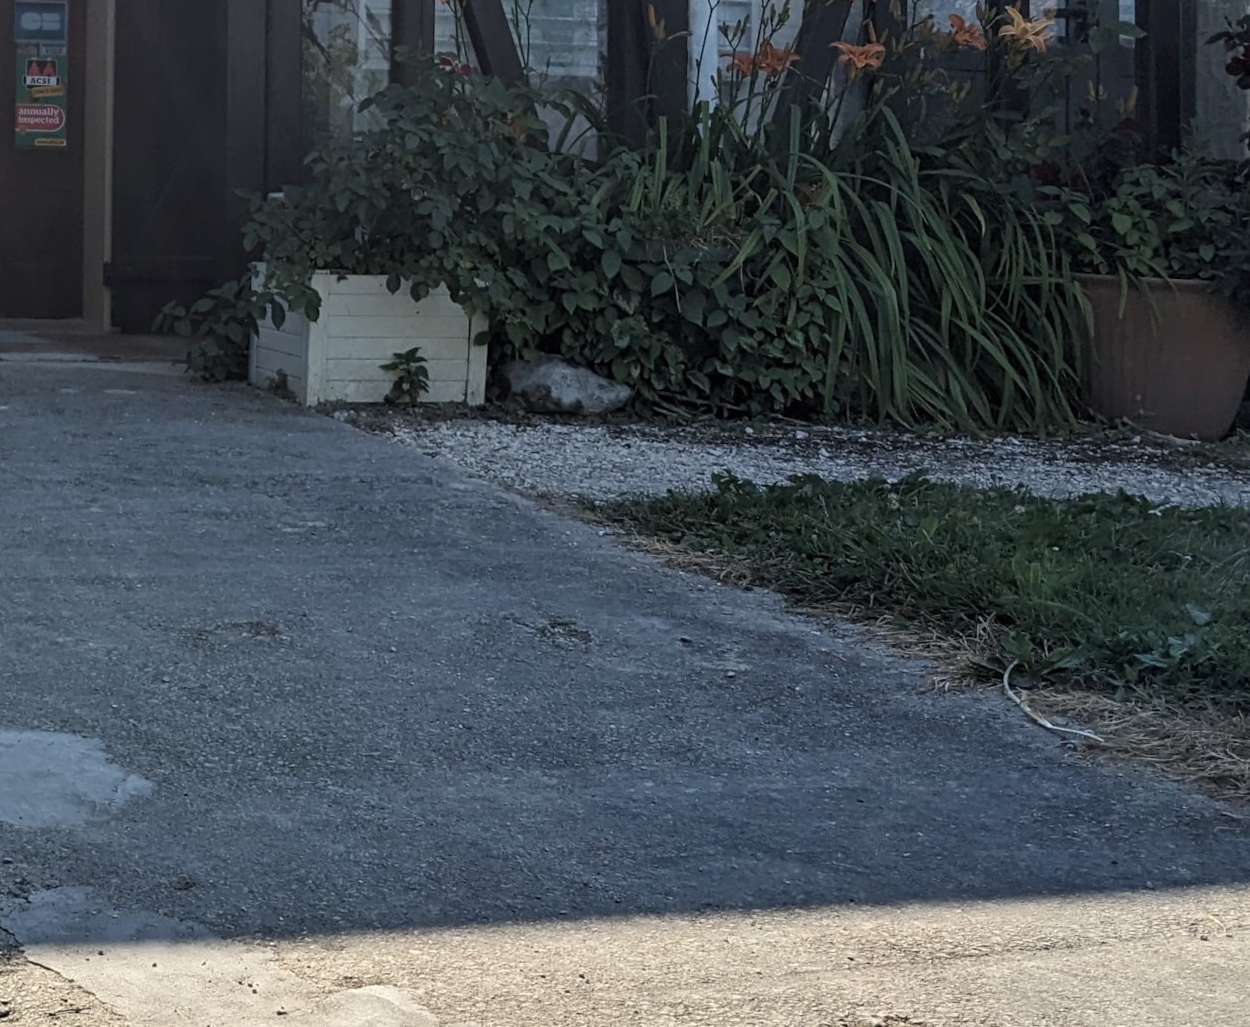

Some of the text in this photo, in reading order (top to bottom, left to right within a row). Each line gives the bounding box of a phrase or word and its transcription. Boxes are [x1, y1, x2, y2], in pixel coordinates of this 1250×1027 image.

[30, 77, 52, 85] ACSI
[18, 107, 60, 118] annually
[18, 116, 60, 126] inspected
